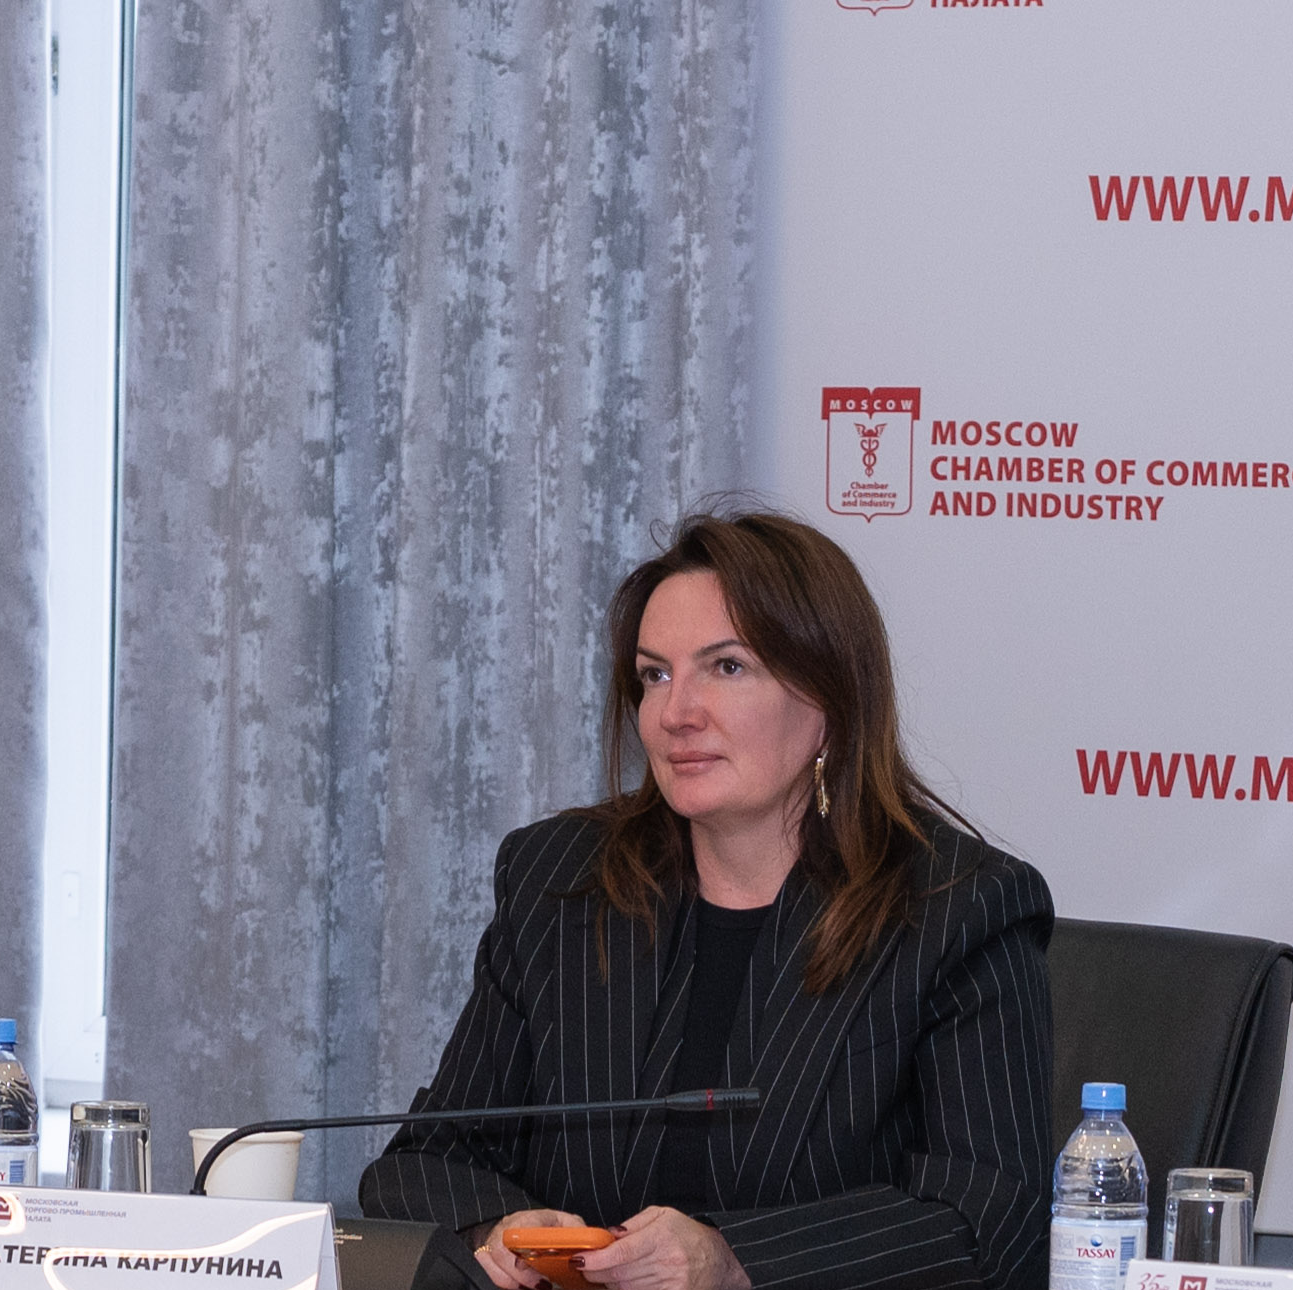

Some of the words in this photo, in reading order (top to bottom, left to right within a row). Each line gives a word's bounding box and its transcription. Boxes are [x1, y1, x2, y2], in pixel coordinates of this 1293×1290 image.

[829, 399, 913, 411] MOSCOW
[931, 420, 1079, 447] MOSCOW
[930, 455, 1085, 483] CHAMBER
[1094, 459, 1137, 485] OF
[850, 481, 889, 490] Chamber
[842, 490, 852, 499] of
[853, 490, 897, 499] Commerce
[842, 499, 858, 508] and
[859, 499, 896, 509] Industry
[929, 490, 997, 517] AND
[1006, 492, 1164, 521] INDUSTRY
[25, 1198, 78, 1207] МОСКОВСКАЯ
[1076, 1247, 1117, 1259] TASSAY
[117, 1252, 284, 1280] КАРПУНИНА
[1215, 1278, 1273, 1288] МОСКОВСКАЯ
